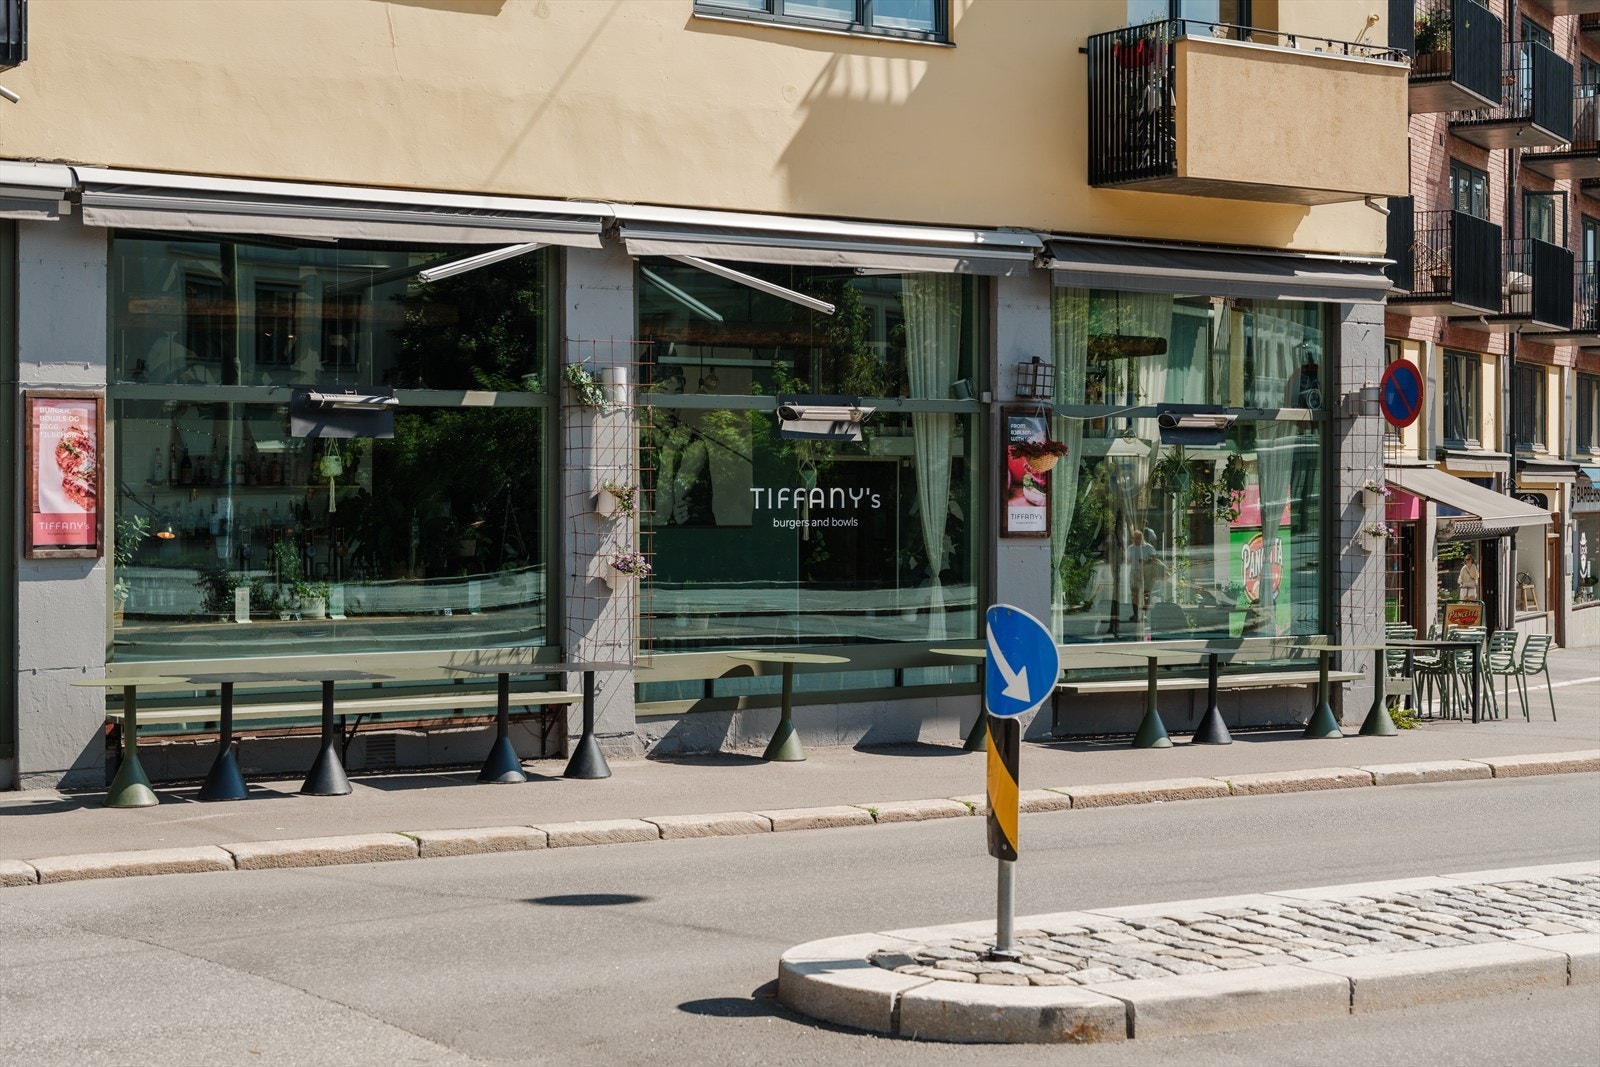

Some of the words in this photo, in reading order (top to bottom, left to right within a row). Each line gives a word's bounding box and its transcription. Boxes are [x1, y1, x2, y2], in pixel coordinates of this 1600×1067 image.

[749, 487, 881, 510] TIFFANY's
[39, 521, 90, 530] TIFFANY's
[773, 517, 810, 530] burgers
[811, 517, 830, 528] and
[831, 517, 859, 528] bowls
